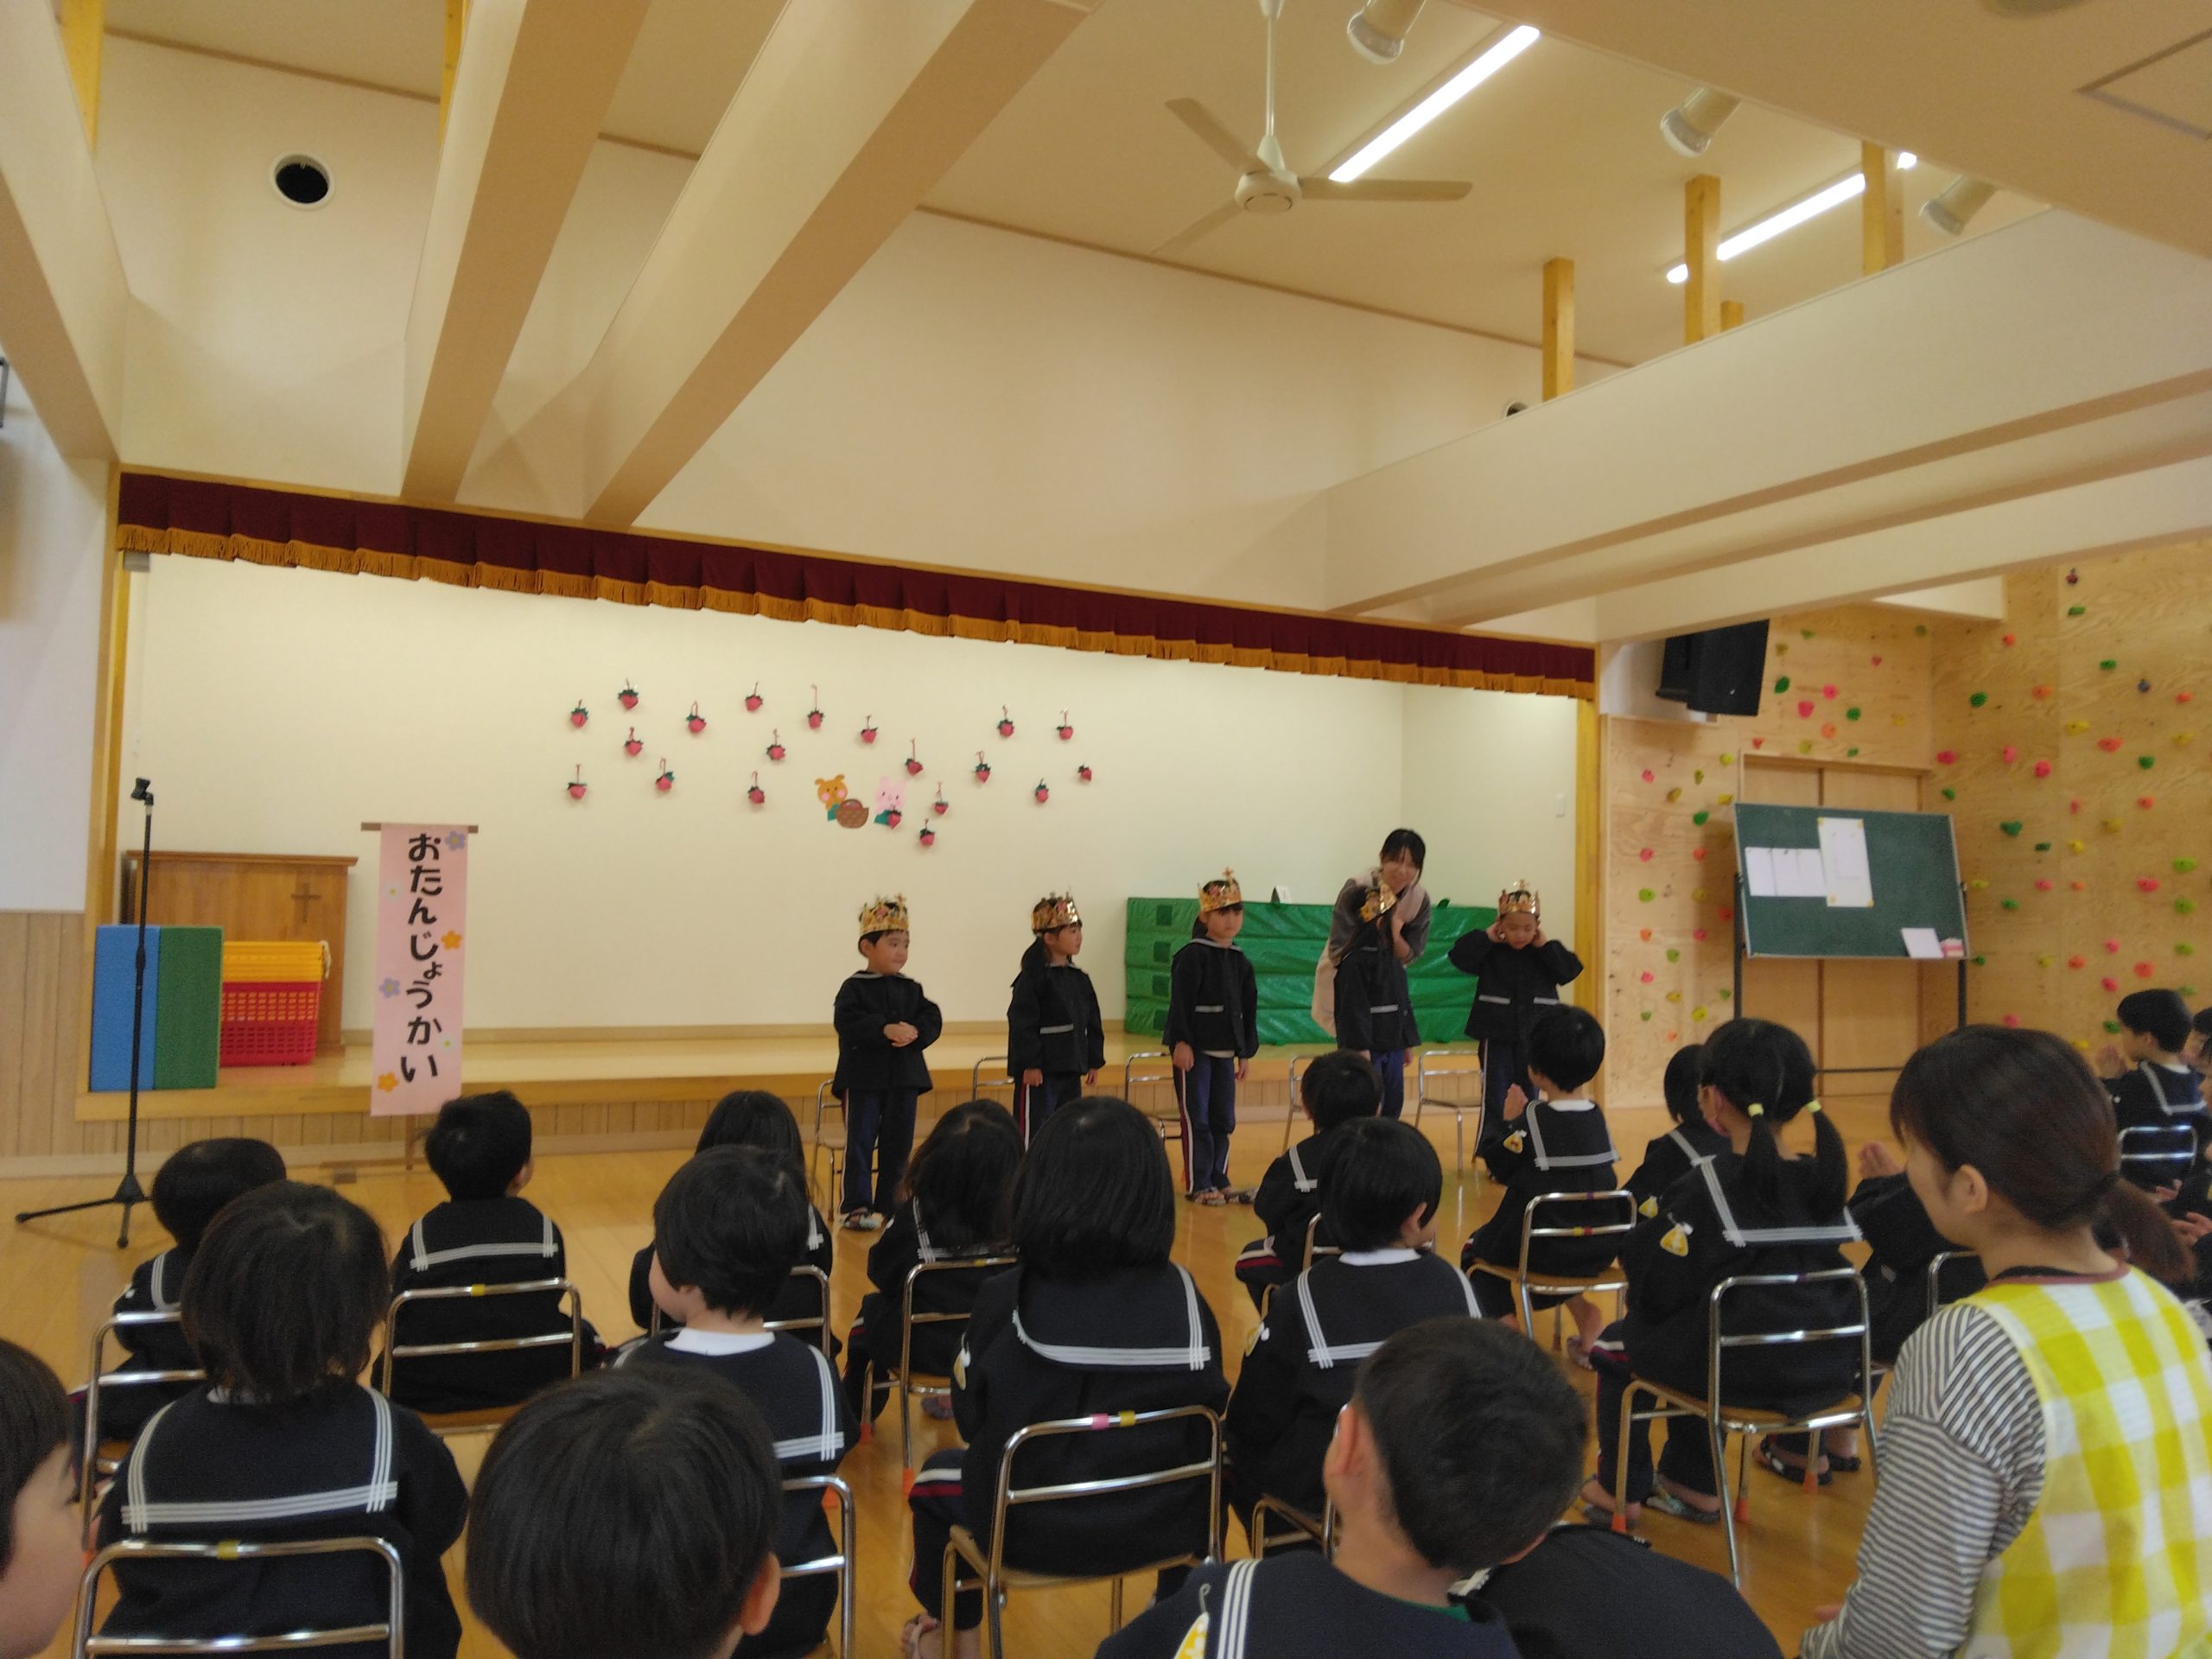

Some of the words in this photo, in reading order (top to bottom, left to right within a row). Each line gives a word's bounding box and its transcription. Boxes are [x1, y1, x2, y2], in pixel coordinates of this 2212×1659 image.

[400, 832, 443, 1083] おたんじょうかい
